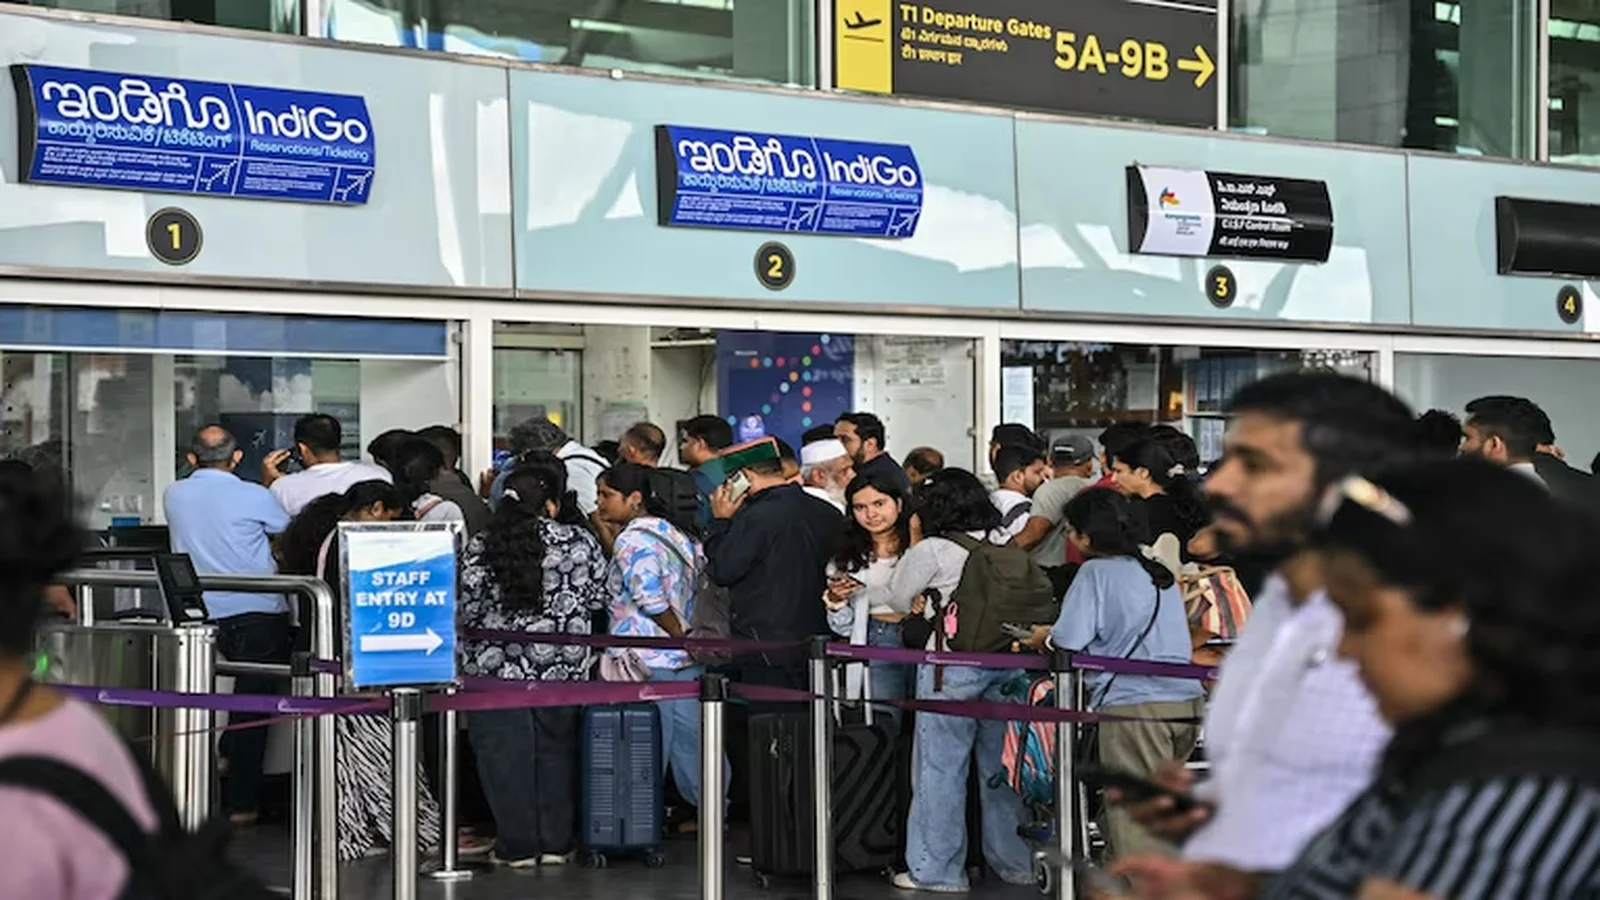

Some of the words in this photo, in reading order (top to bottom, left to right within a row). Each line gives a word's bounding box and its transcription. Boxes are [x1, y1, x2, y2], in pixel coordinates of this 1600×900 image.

[900, 4, 918, 23] T1
[922, 7, 1004, 34] Departure
[1006, 18, 1052, 39] Gates
[1054, 31, 1169, 81] 5A-9B
[244, 100, 368, 144] IndiGo
[250, 139, 369, 163] Reservations/Ticketing
[823, 152, 918, 187] IndiGo
[167, 223, 180, 249] 1
[767, 255, 783, 277] 2
[1215, 277, 1228, 297] 3
[1564, 296, 1575, 313] 4
[371, 571, 431, 586] STAFF
[355, 592, 418, 606] ENTRY
[424, 591, 447, 606] AT
[388, 612, 415, 628] 9D
